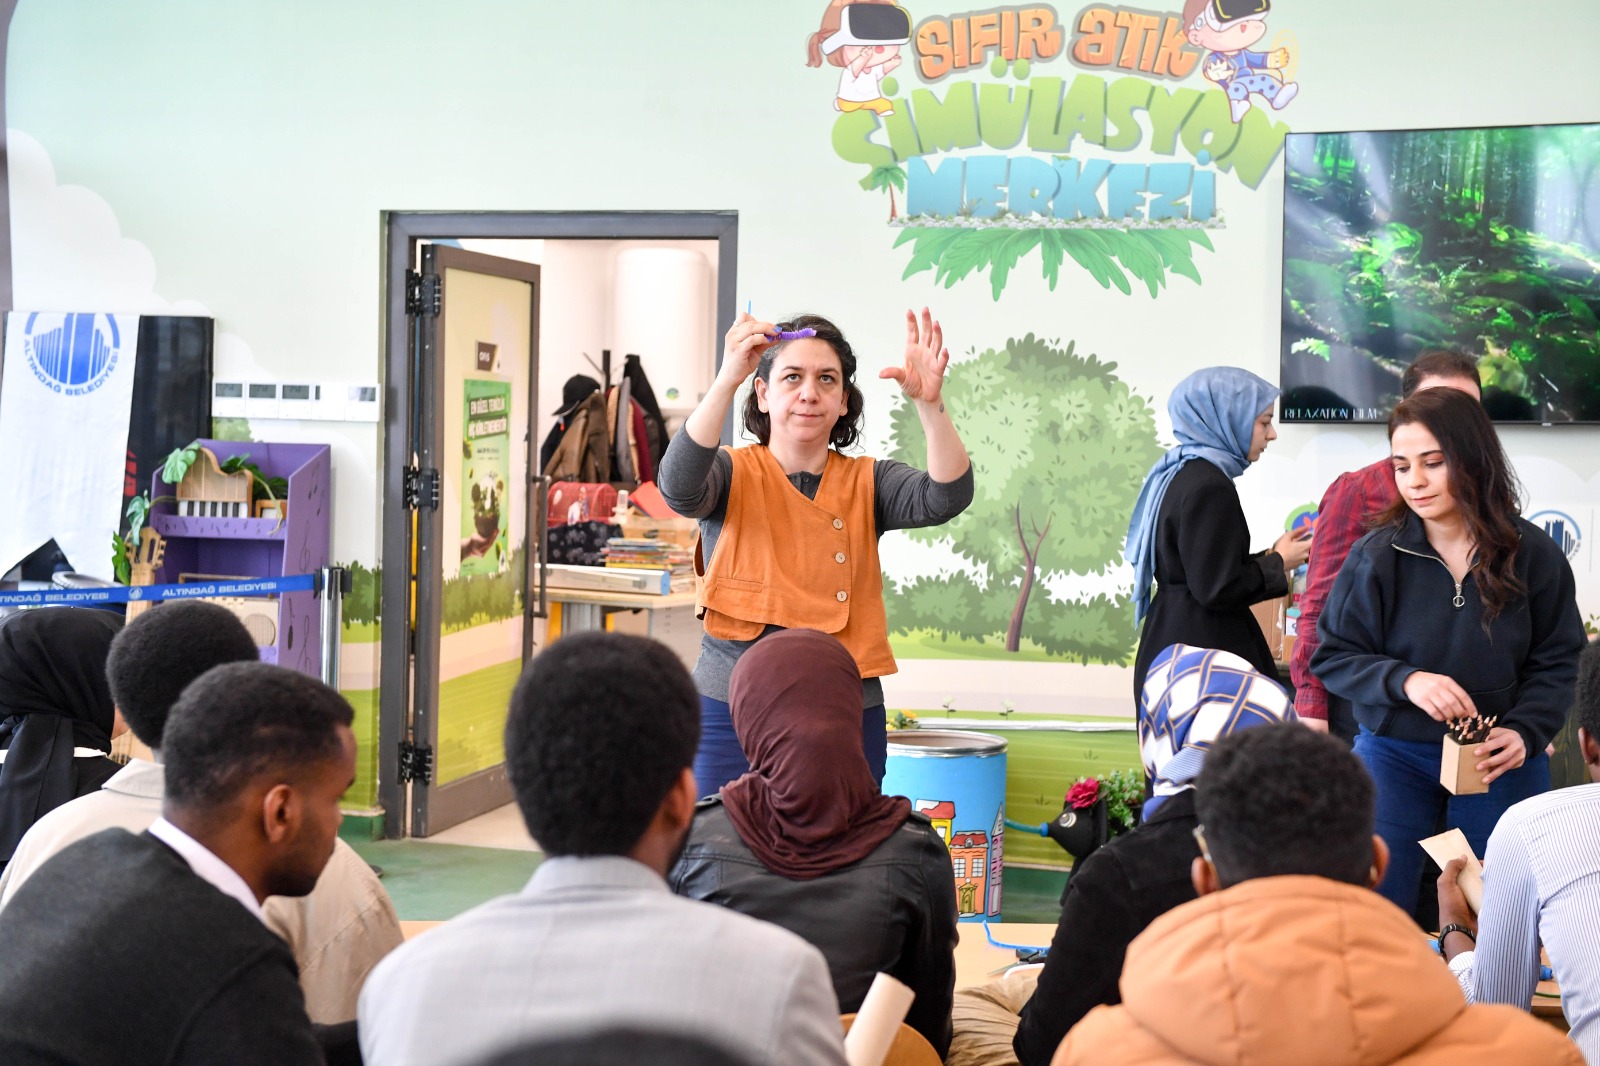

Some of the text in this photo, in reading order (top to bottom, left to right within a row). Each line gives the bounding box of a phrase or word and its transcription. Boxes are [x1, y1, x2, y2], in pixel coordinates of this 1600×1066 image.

[916, 8, 1061, 80] SIFIR
[906, 149, 1216, 220] MERKEZİ
[162, 585, 215, 597] ALTINDAĞ
